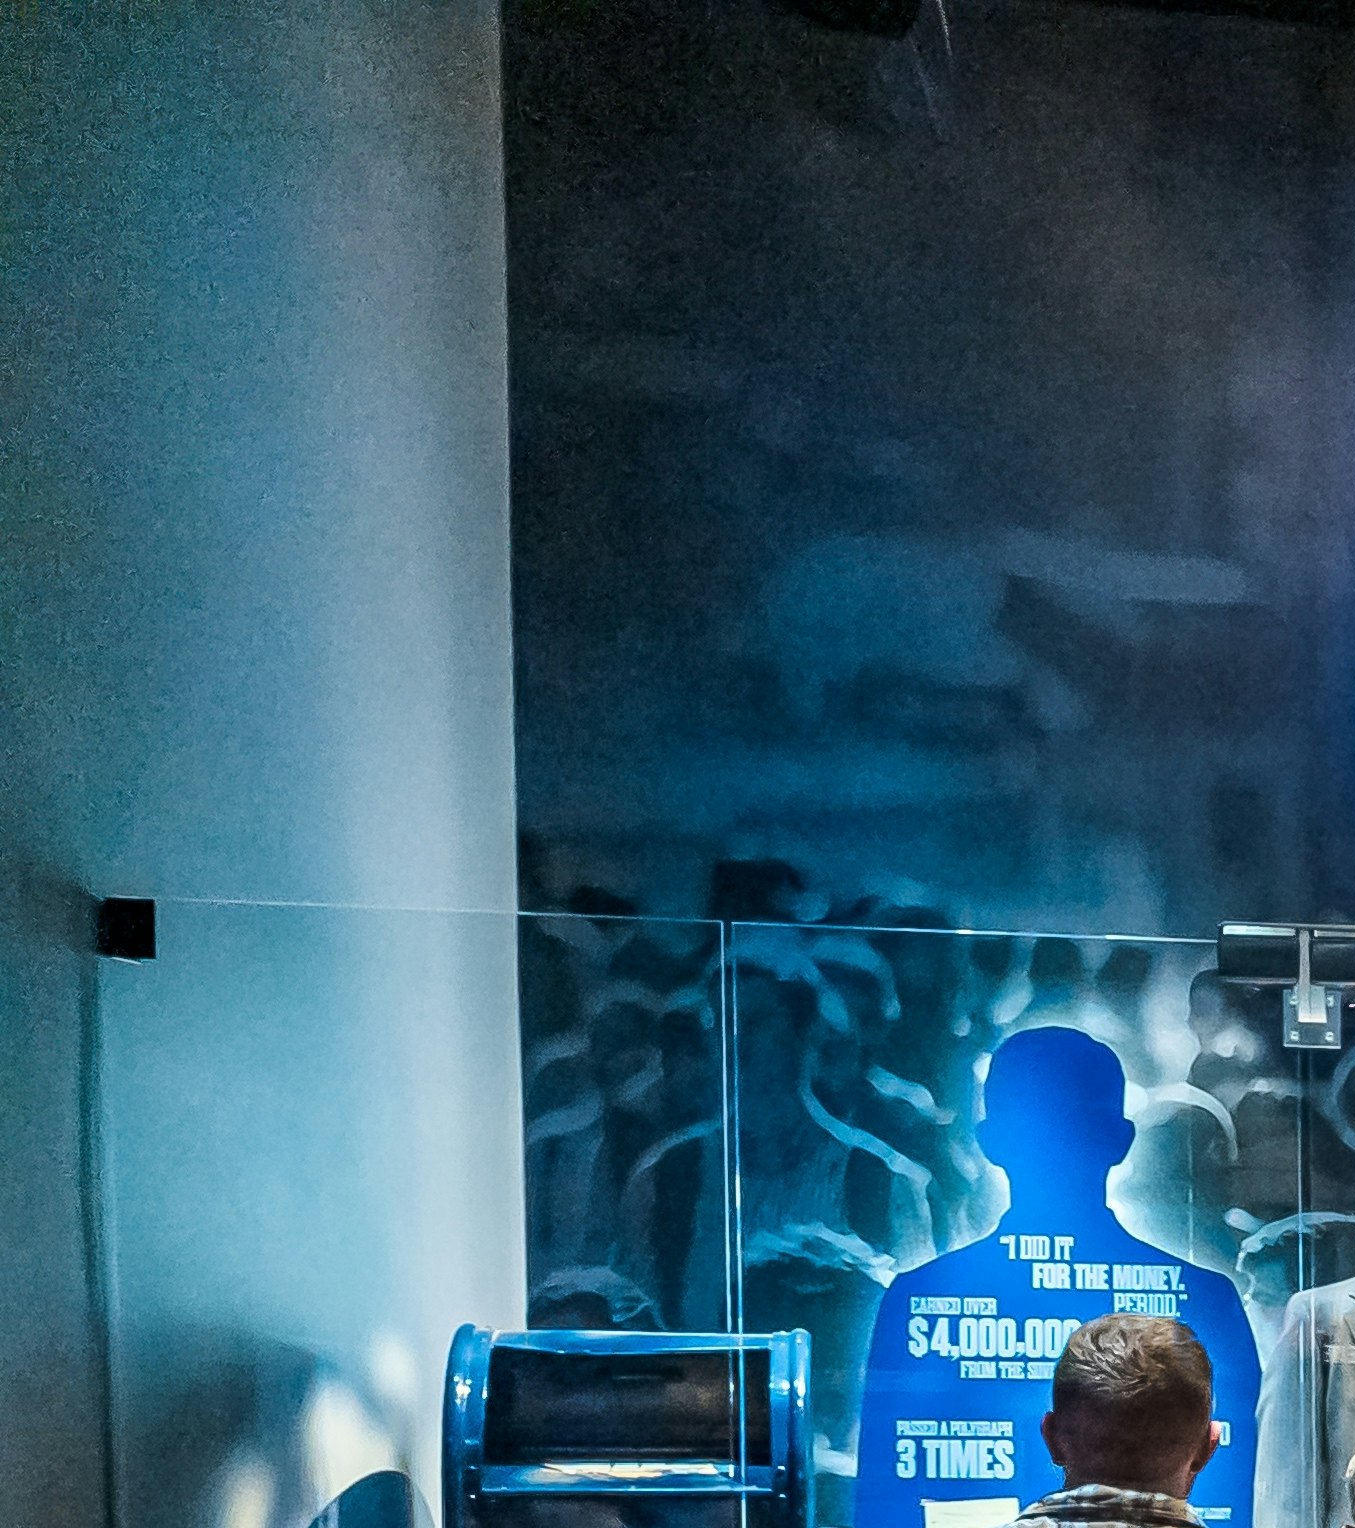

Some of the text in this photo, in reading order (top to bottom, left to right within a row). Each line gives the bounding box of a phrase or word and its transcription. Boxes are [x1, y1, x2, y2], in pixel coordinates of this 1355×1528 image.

[1019, 1235, 1049, 1260] DID
[1054, 1236, 1074, 1260] IT
[1032, 1263, 1185, 1291] FOR THE MONEY.
[910, 1297, 997, 1315] EARNED OVER
[960, 1362, 996, 1379] FROM
[1000, 1362, 1025, 1379] THE
[940, 1421, 949, 1436] A
[896, 1439, 1015, 1479] 3 TIMES
